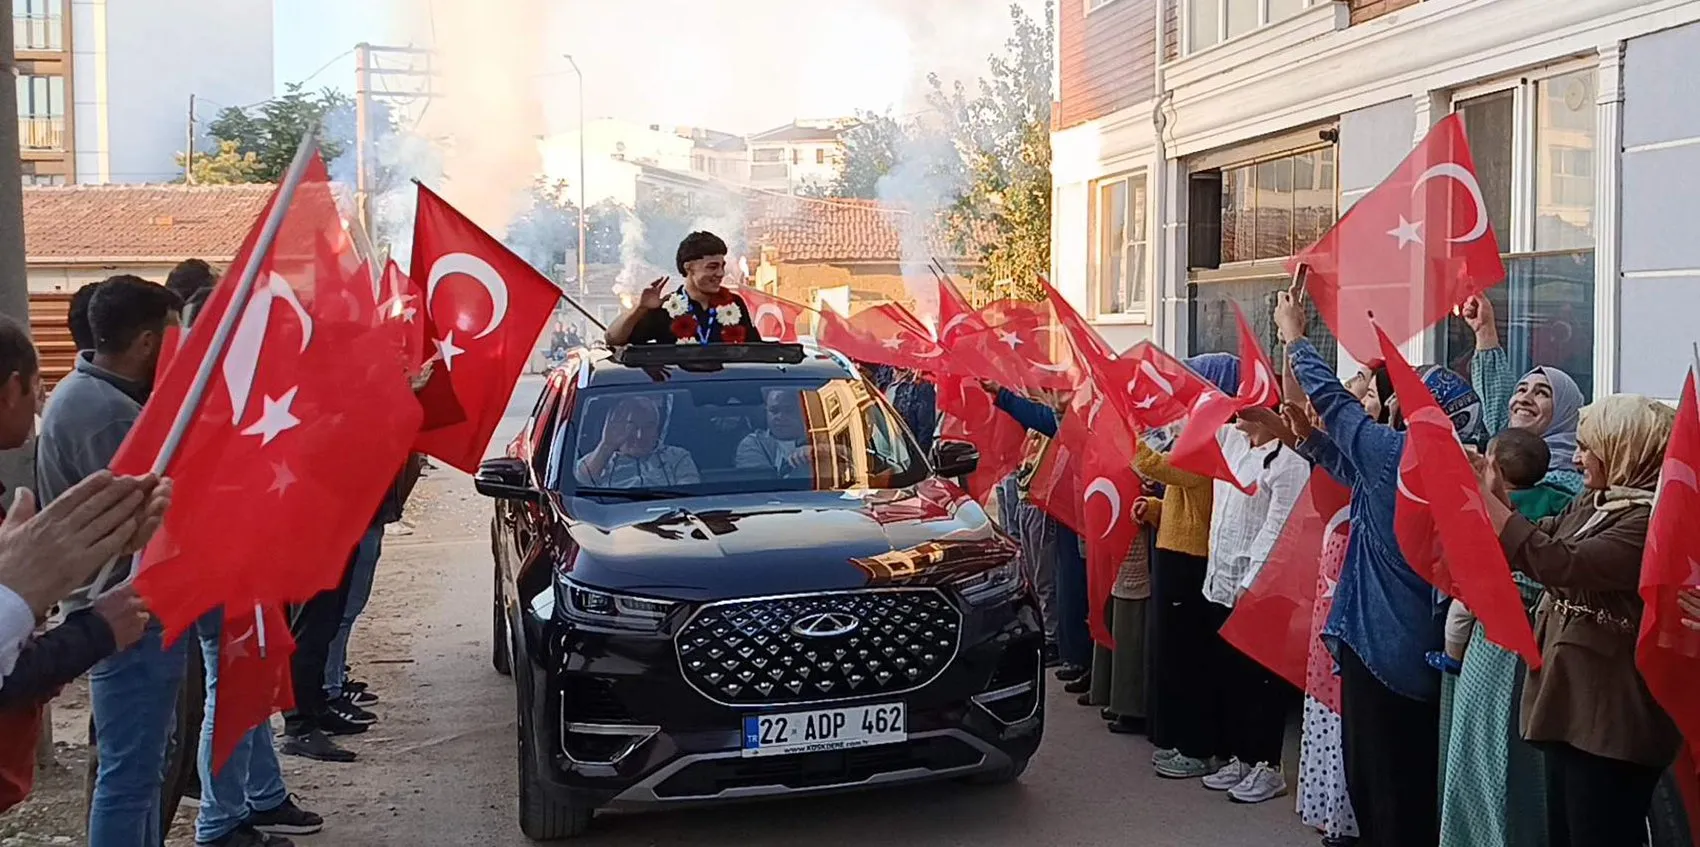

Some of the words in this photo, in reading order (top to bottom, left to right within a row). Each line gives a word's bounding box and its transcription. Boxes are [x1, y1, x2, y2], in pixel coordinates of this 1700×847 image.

[760, 717, 789, 745] 22
[804, 712, 846, 741] ADP
[861, 706, 902, 734] 462
[747, 735, 758, 743] TR
